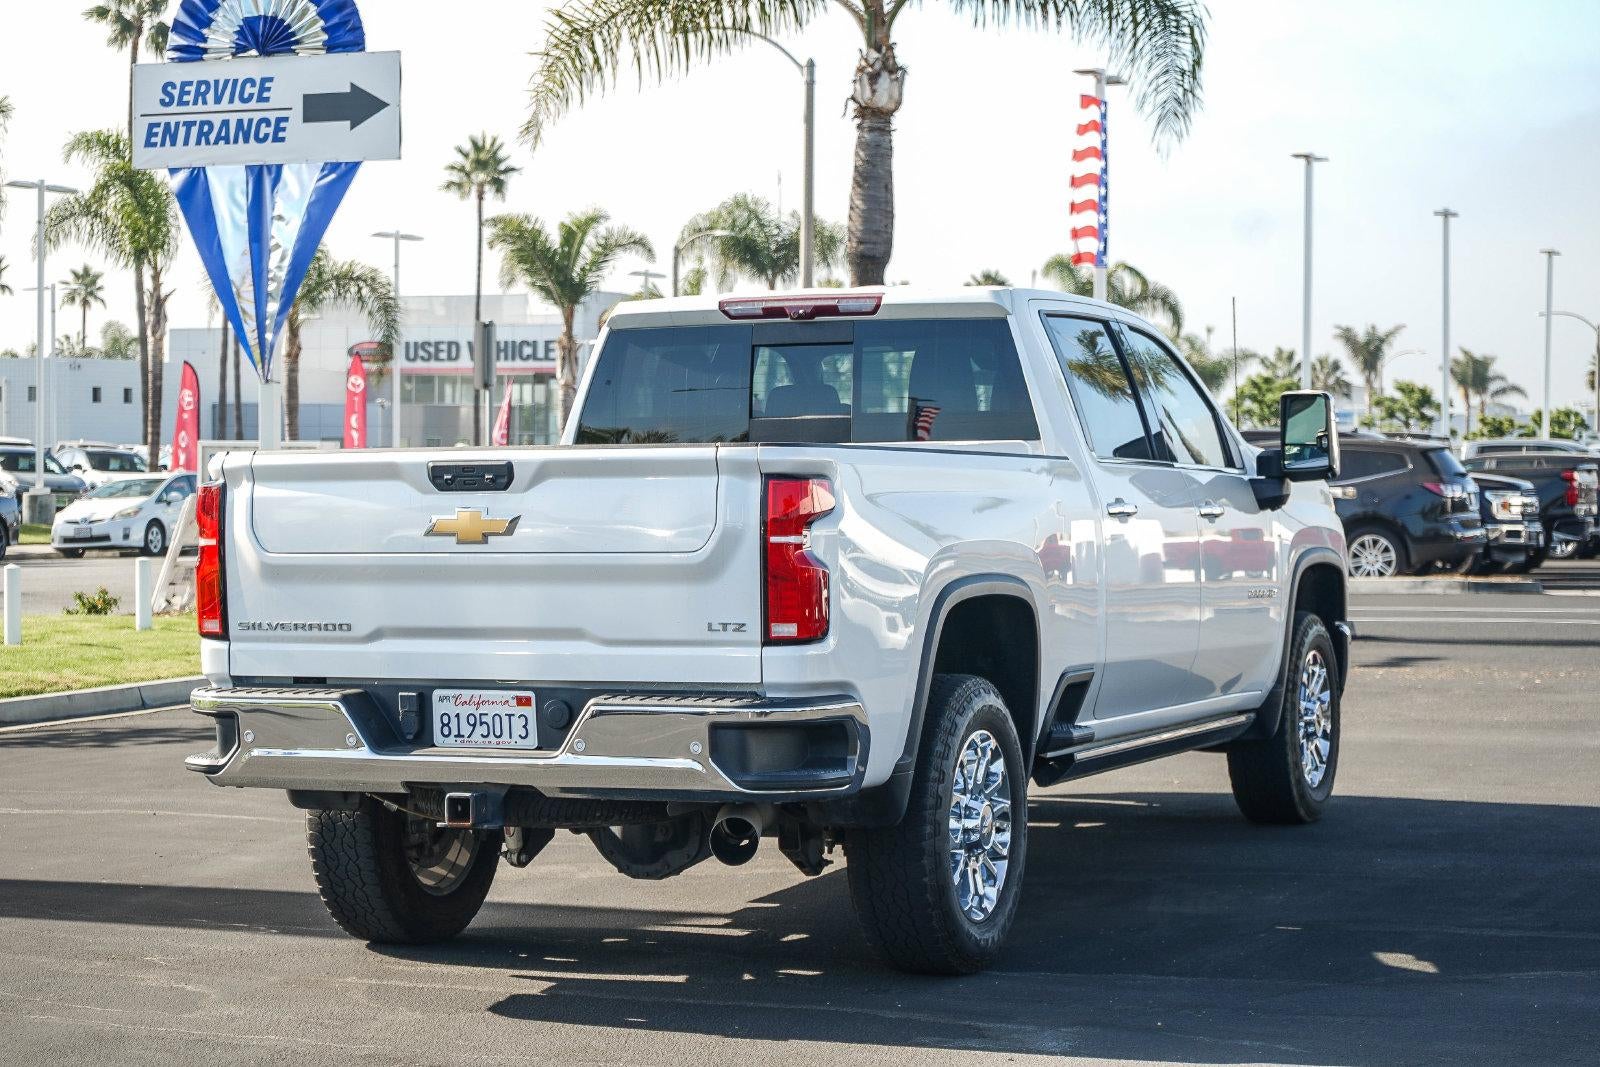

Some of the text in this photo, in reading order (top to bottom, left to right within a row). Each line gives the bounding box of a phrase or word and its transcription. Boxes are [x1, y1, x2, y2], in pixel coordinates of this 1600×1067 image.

[159, 76, 275, 107] SERVICE
[144, 116, 290, 148] ENTRANCE
[404, 339, 557, 362] USED HICLE
[237, 621, 352, 632] SILVERADO
[707, 622, 747, 632] LTZ
[454, 693, 511, 710] California
[440, 712, 529, 740] 81950T3
